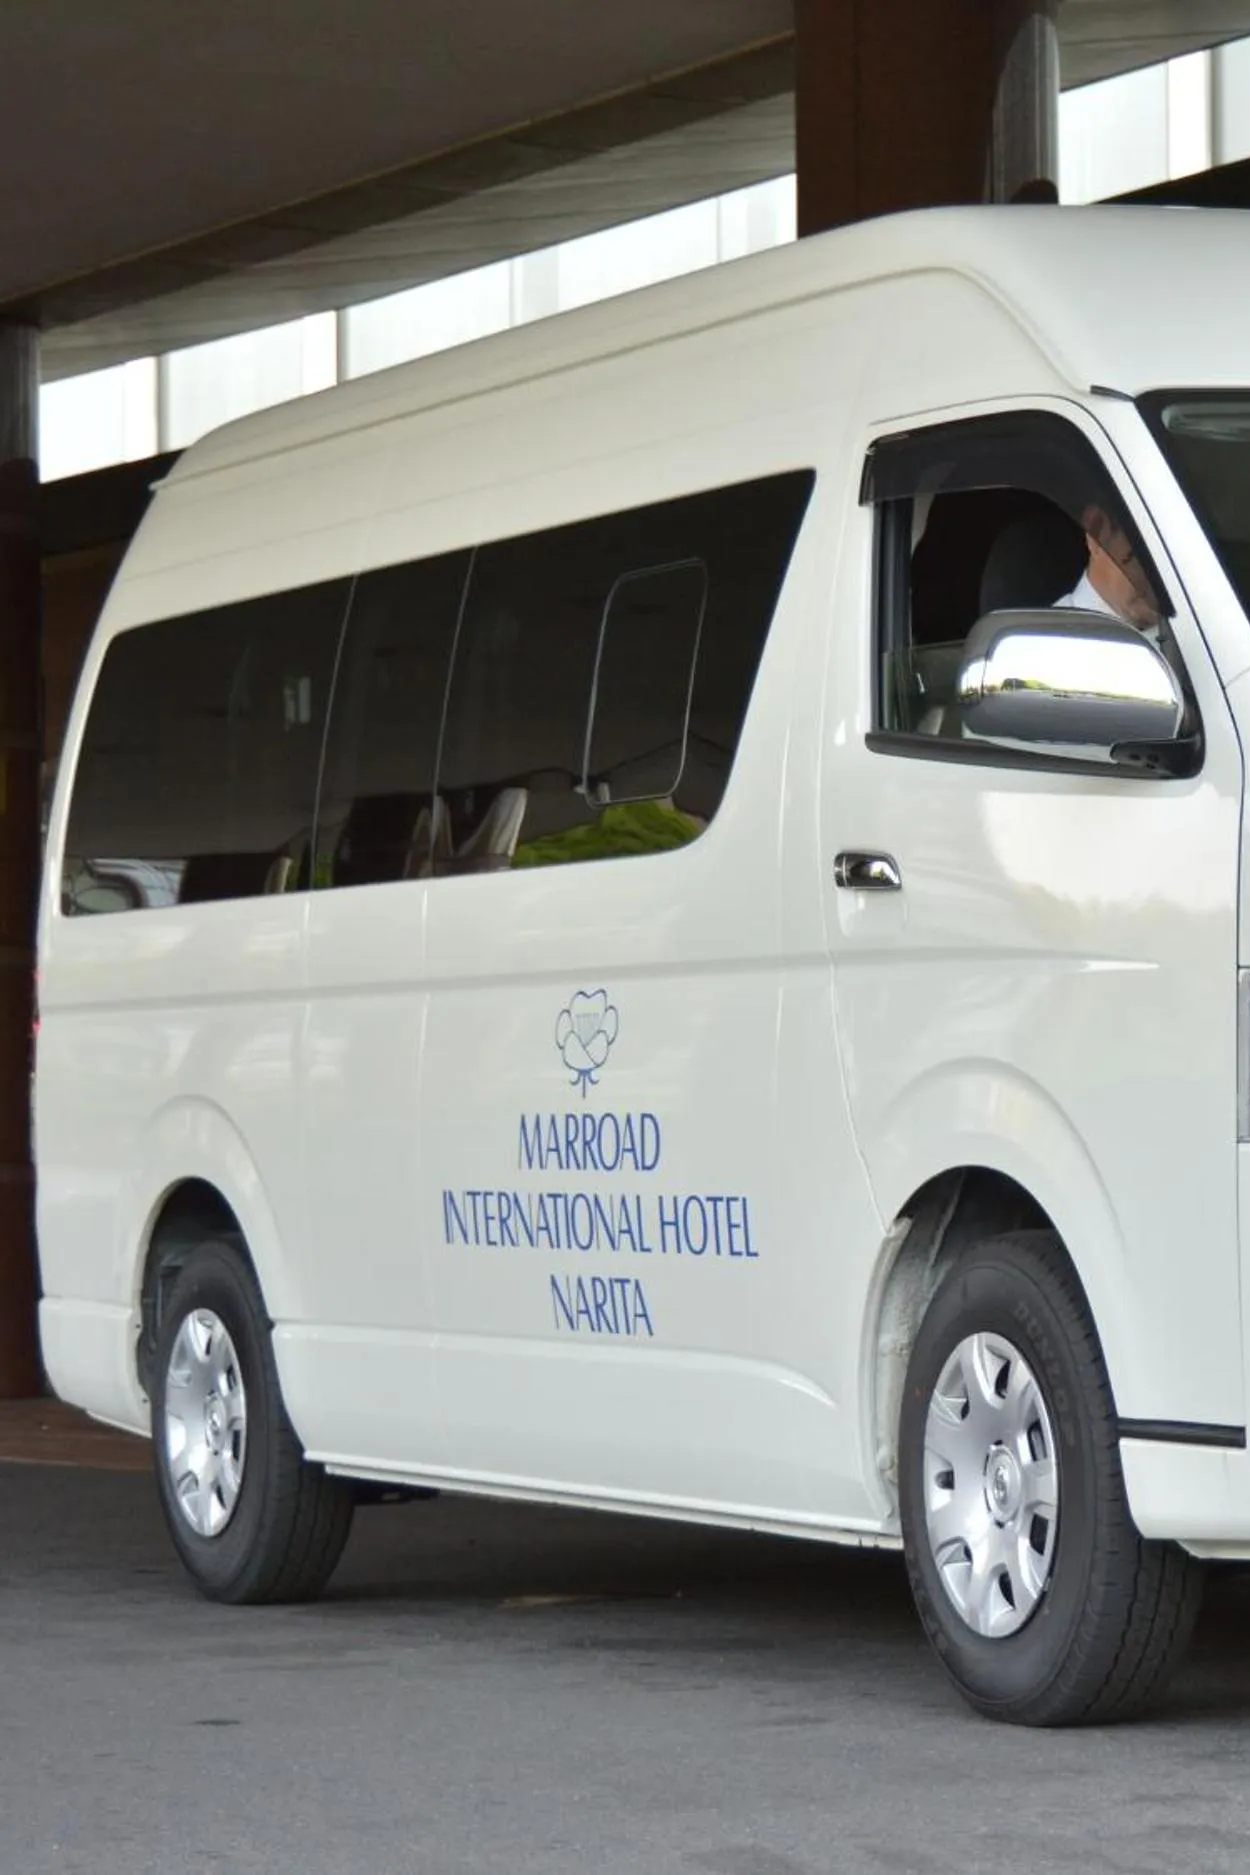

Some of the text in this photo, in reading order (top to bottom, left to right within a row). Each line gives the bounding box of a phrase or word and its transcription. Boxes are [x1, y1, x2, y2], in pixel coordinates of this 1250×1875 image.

[517, 1111, 662, 1172] MARROAD
[441, 1188, 761, 1259] INTERNATIONAL HOTEL
[549, 1272, 655, 1338] NARITA
